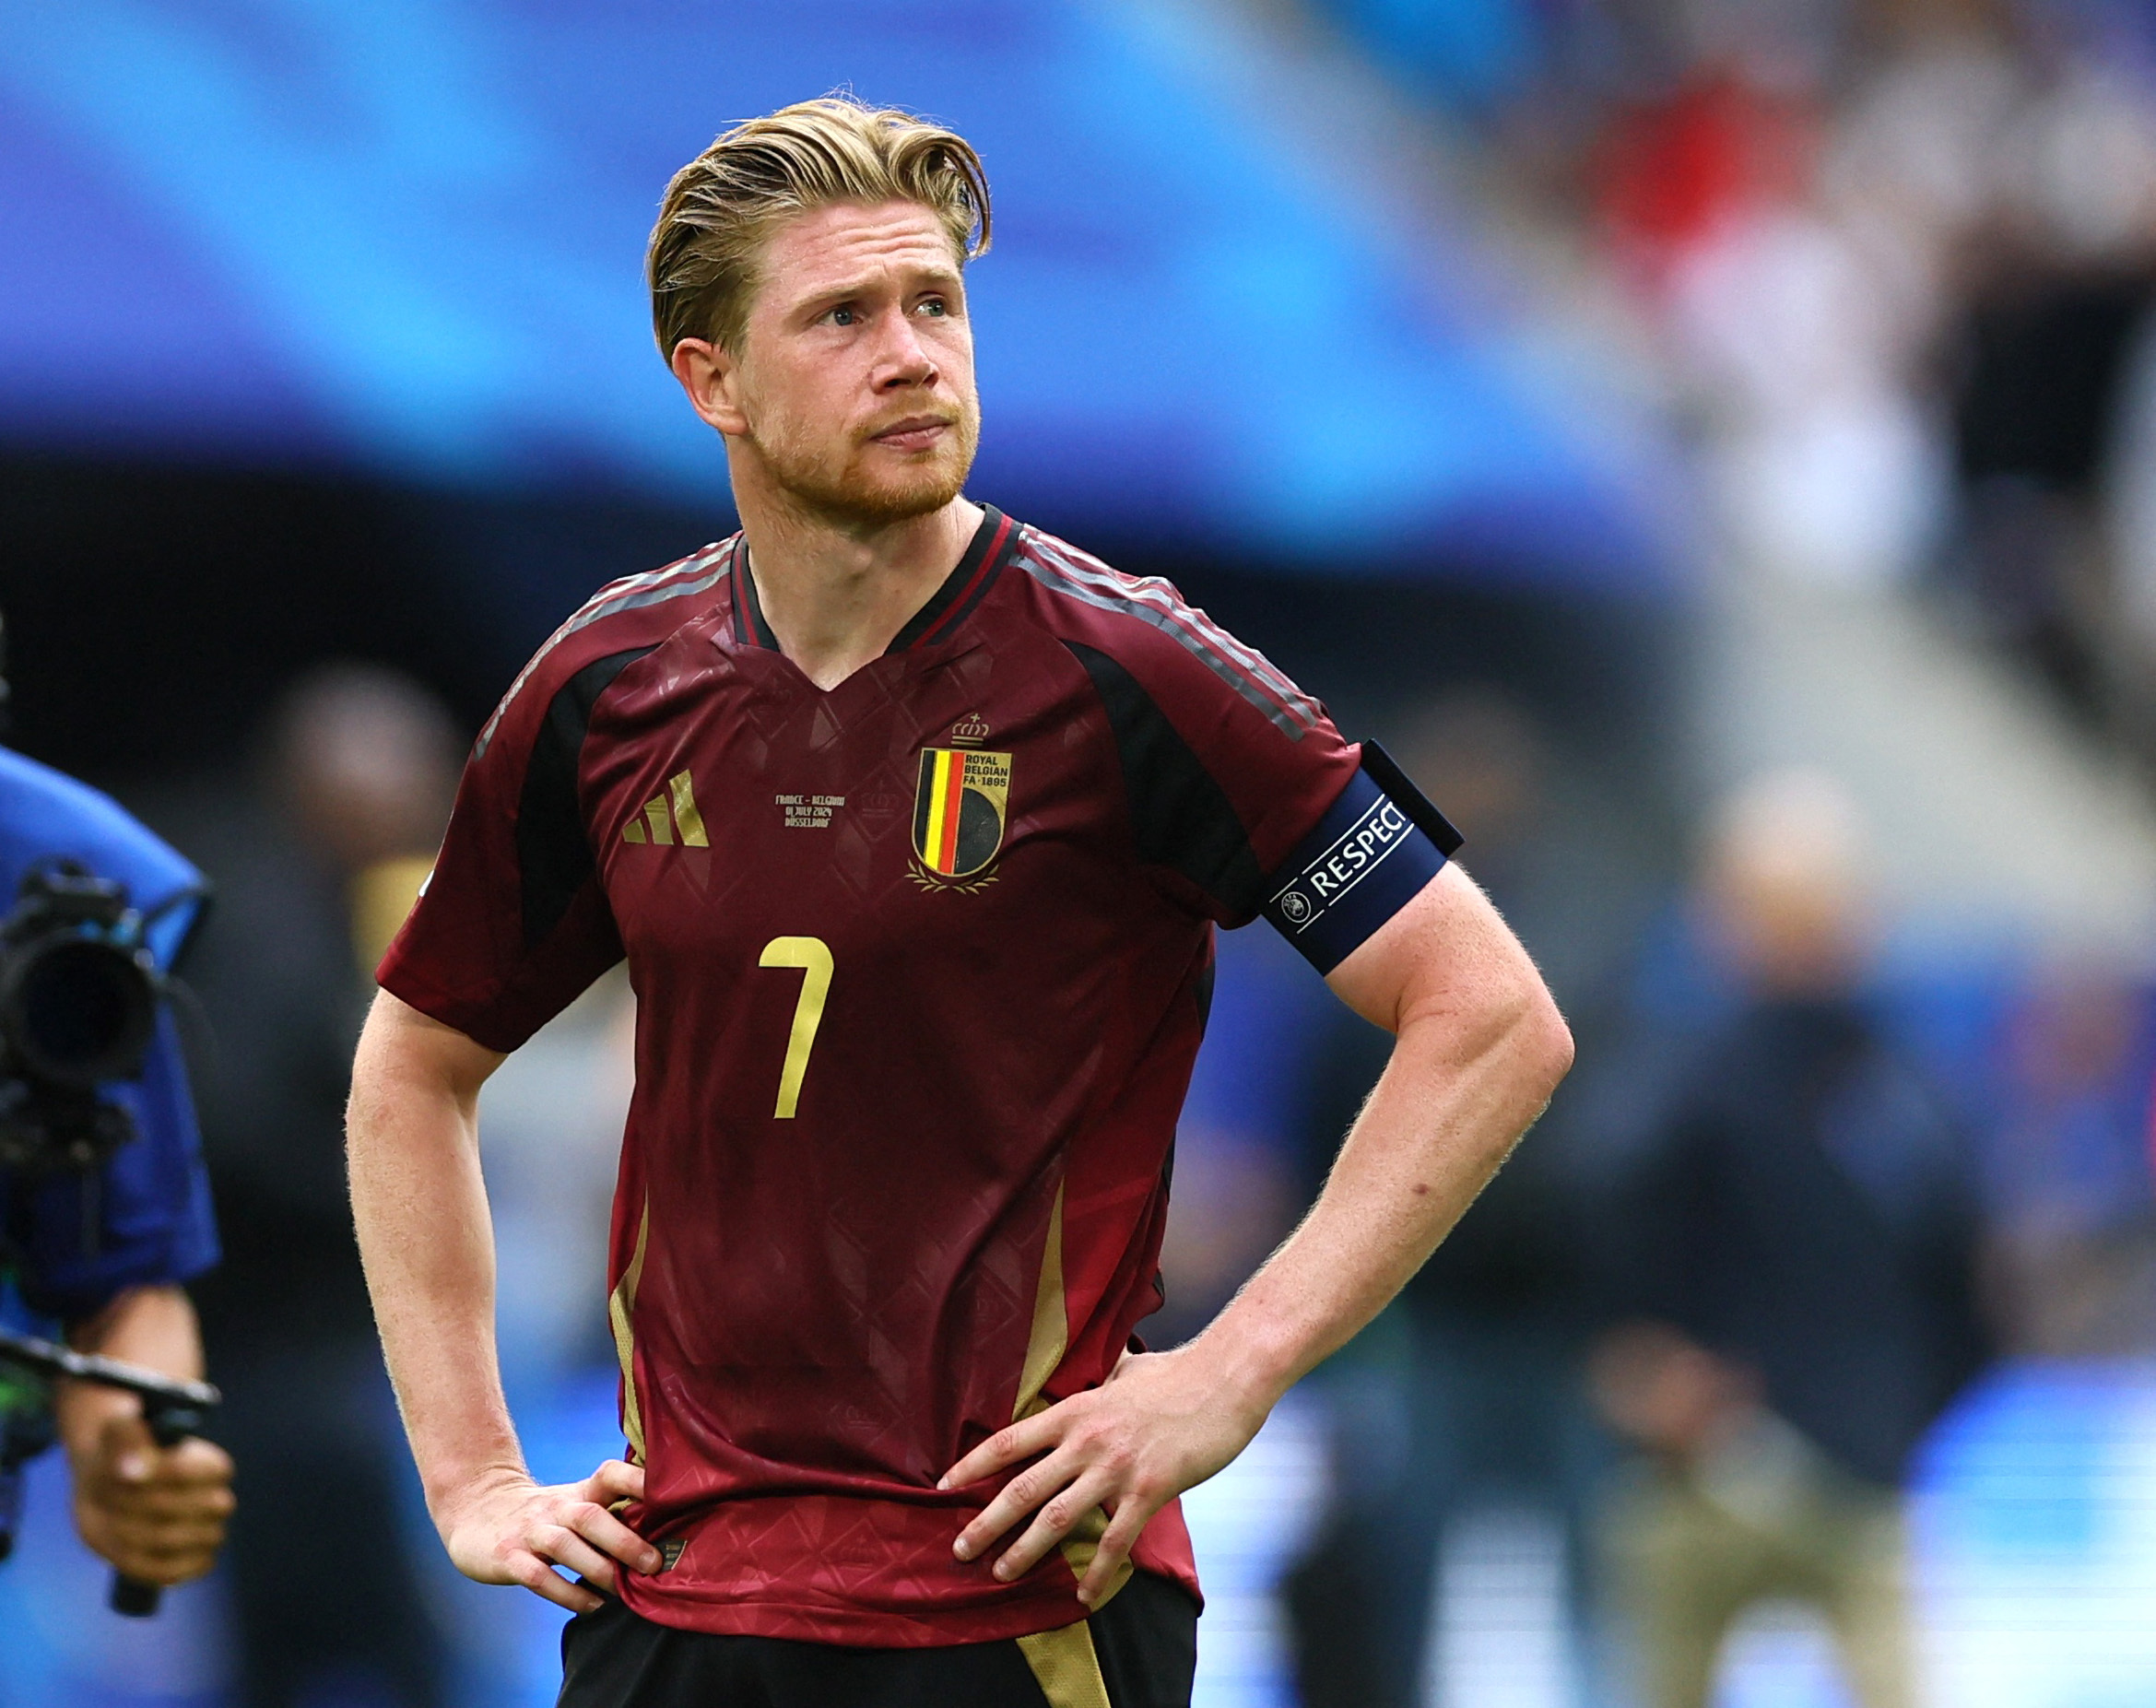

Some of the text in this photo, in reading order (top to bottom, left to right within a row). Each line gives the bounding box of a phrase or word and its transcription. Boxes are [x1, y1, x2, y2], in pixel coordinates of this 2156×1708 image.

[965, 755, 997, 765] ROYAL
[964, 765, 1007, 776] BELGIAN
[963, 775, 976, 784] FA
[982, 777, 1007, 786] 1895
[775, 795, 804, 805] FRANCE
[812, 795, 845, 806] BELGIUM
[795, 807, 812, 816] JULY
[813, 807, 832, 817] 2024
[759, 936, 834, 1119] 7
